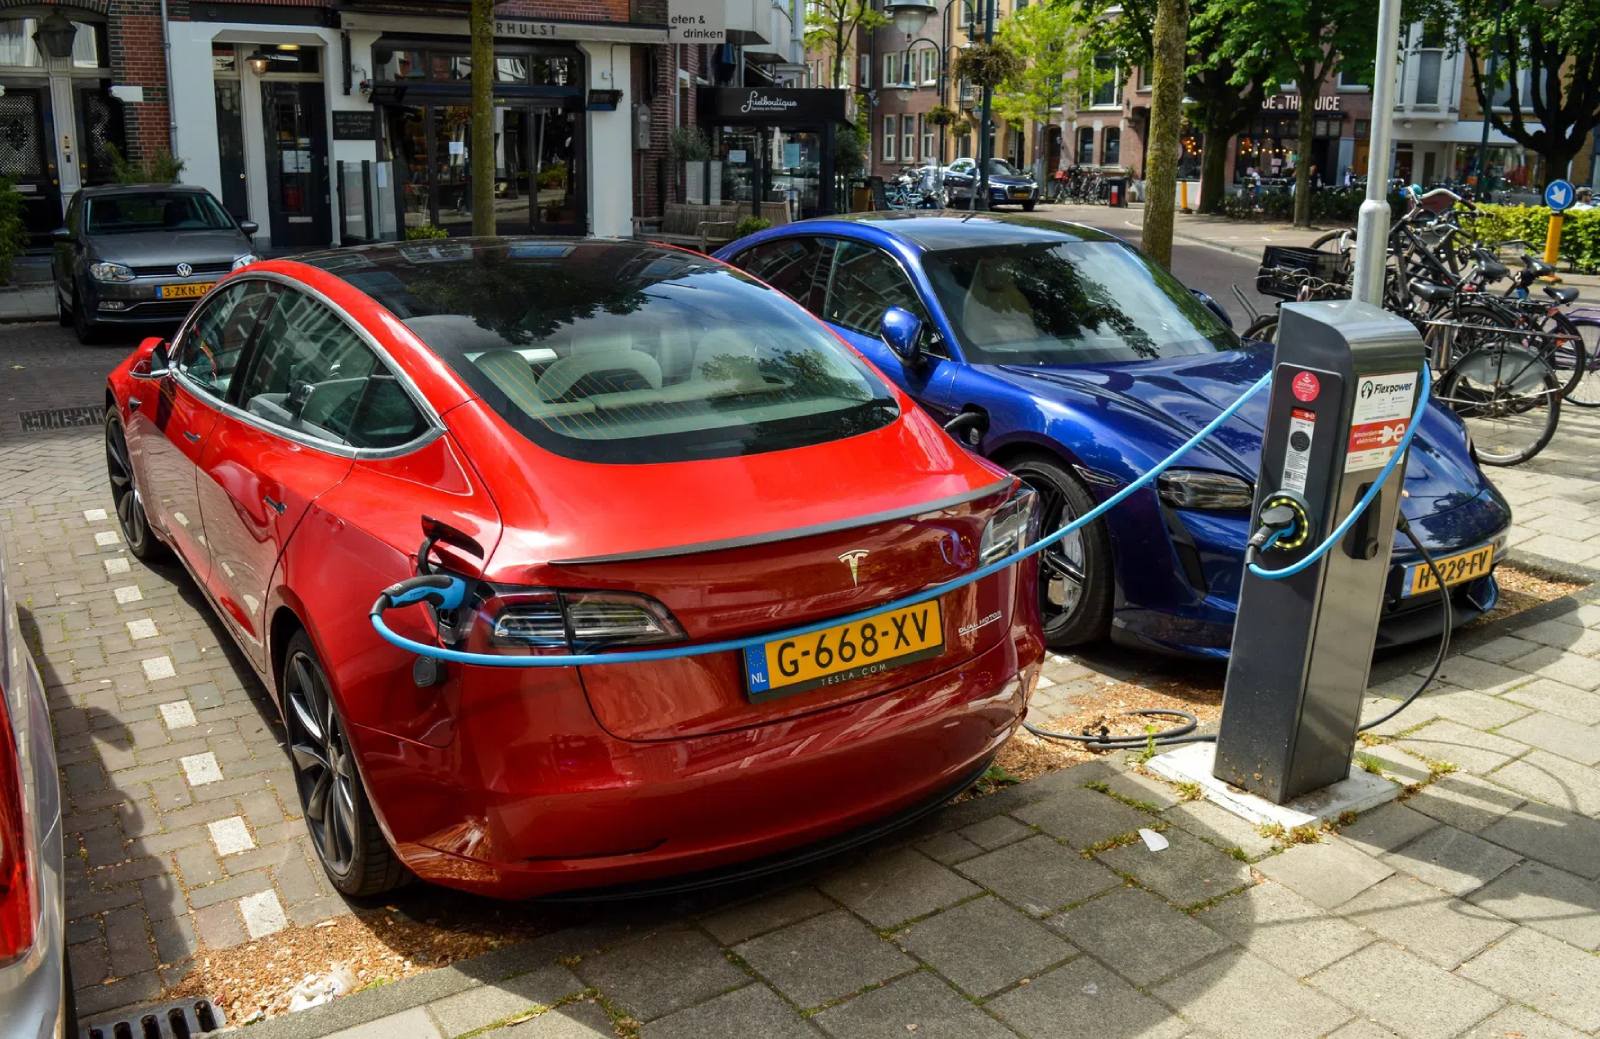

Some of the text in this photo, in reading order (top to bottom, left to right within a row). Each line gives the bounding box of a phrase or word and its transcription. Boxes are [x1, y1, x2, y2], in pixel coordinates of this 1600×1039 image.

[671, 14, 706, 24] eten &
[495, 22, 556, 36] RHULST
[683, 28, 723, 38] drinken
[1314, 96, 1340, 111] UICE
[1373, 382, 1413, 396] Flexpower
[979, 610, 1002, 625] MOTOR
[777, 609, 929, 678] G-668-XV
[751, 673, 766, 685] NL
[820, 663, 887, 686] TESLA.COM
